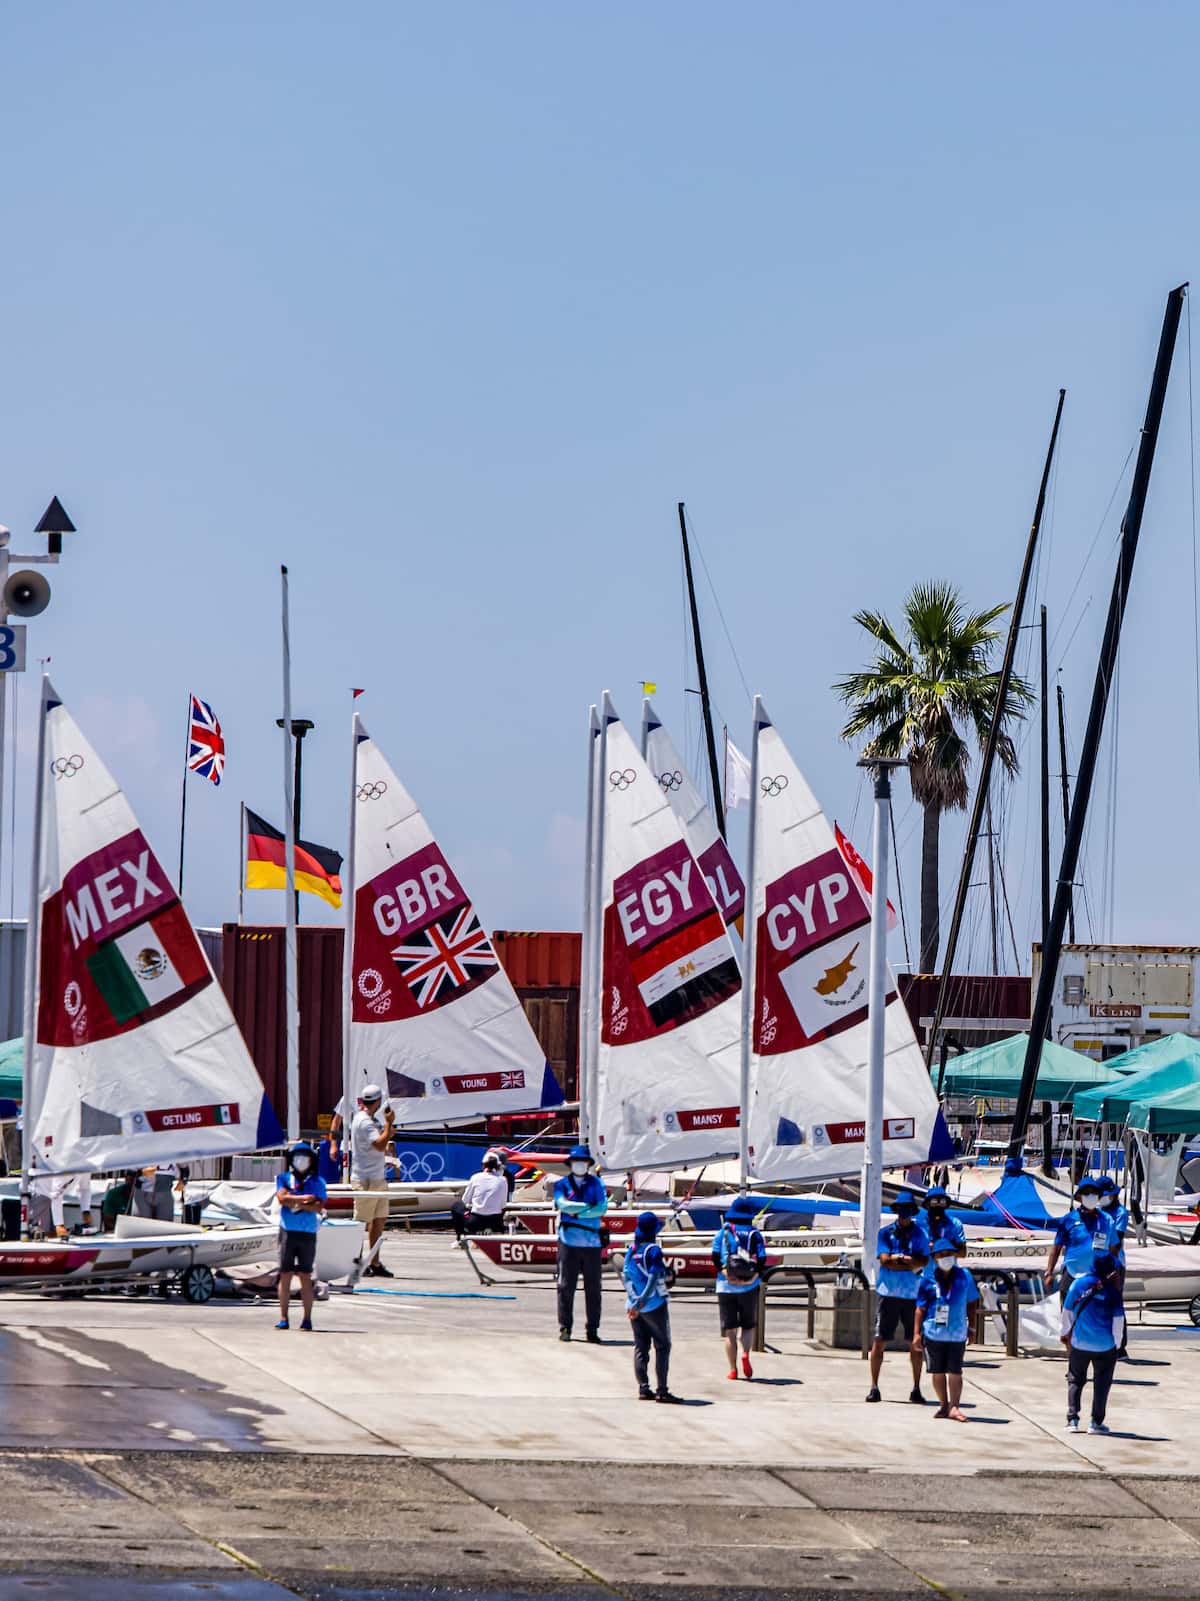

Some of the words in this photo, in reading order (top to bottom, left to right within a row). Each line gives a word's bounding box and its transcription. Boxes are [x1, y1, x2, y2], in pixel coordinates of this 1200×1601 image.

[65, 850, 163, 949] MEX
[373, 864, 455, 936] GBR
[617, 859, 694, 947] EGY
[766, 872, 849, 951] CYP
[1096, 1007, 1107, 1017] K
[460, 1078, 488, 1089] YOUNG
[162, 1112, 202, 1126] OETLING
[692, 1114, 723, 1126] MANSY
[844, 1127, 865, 1139] MAK
[811, 1238, 836, 1247] 2020
[500, 1243, 534, 1262] EGY
